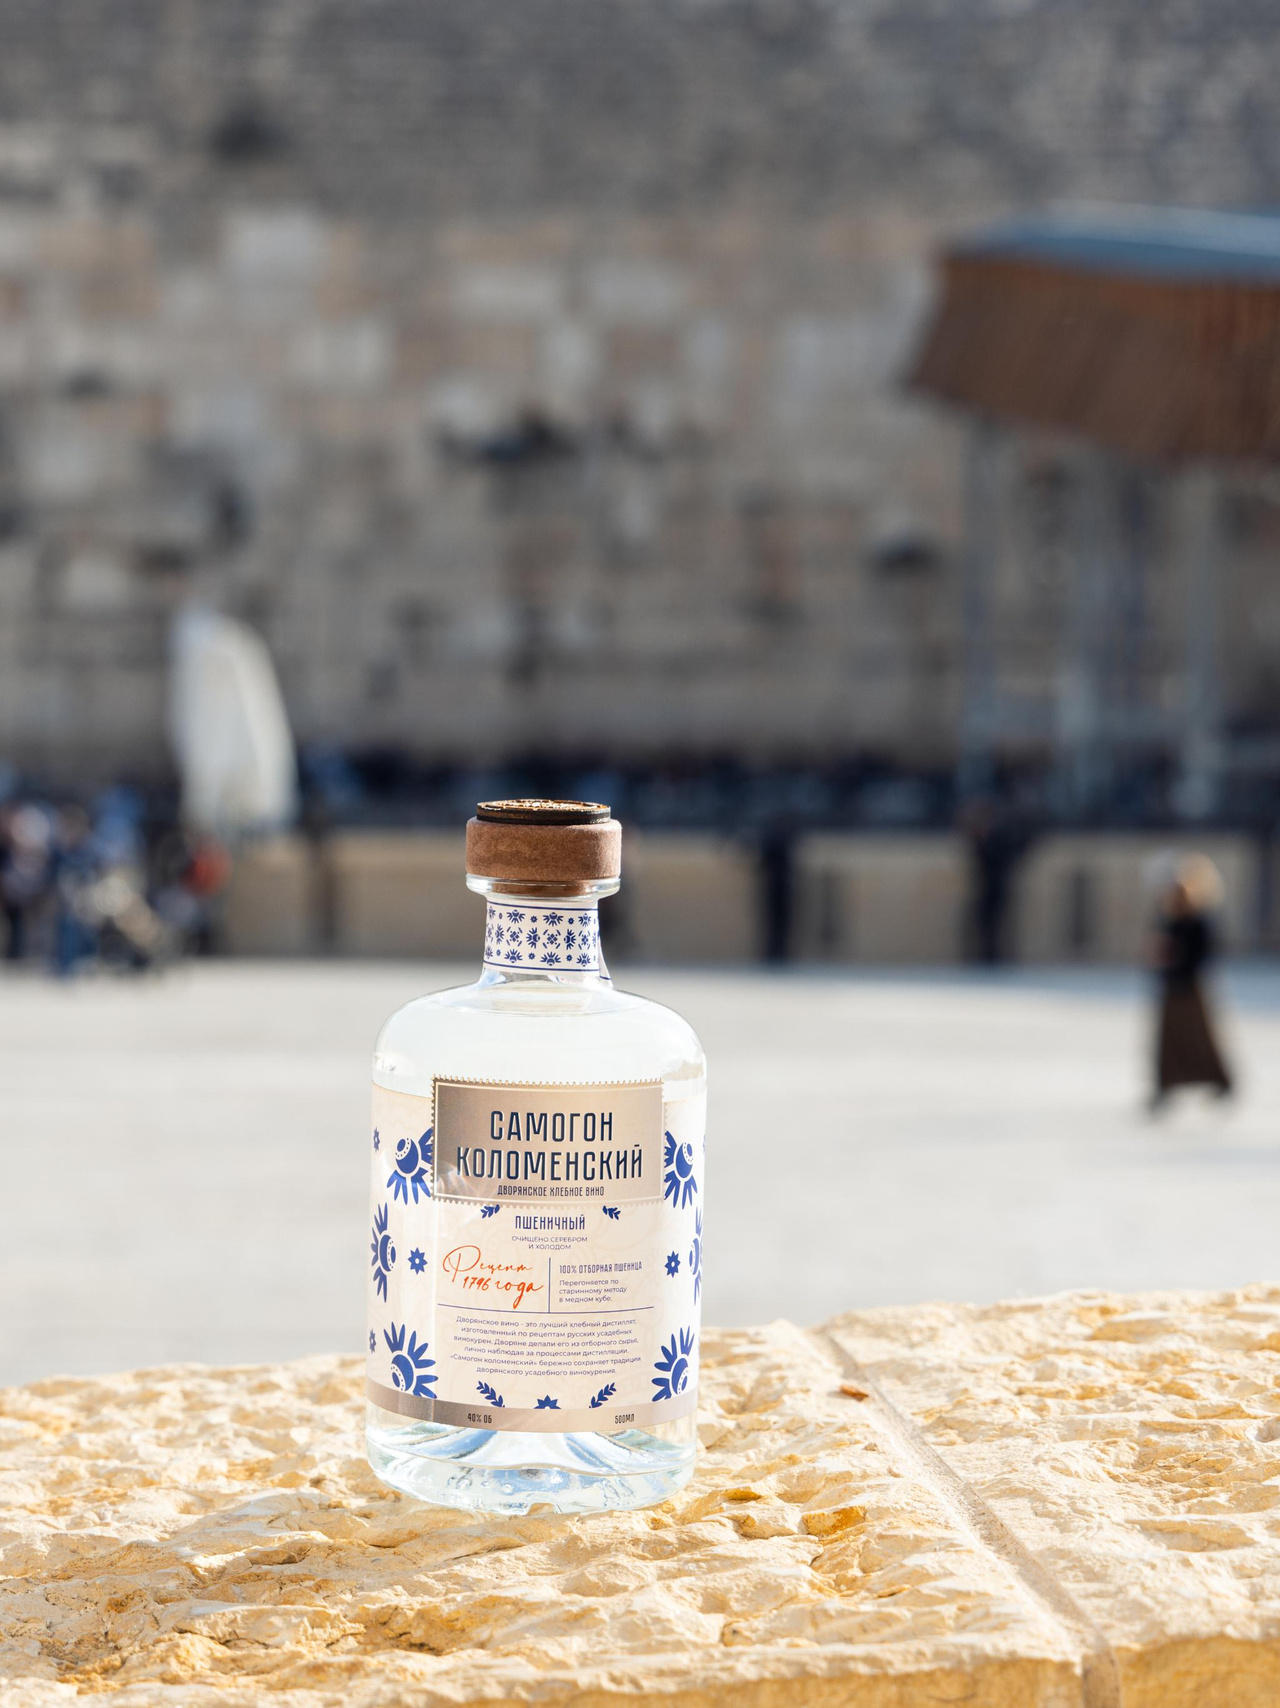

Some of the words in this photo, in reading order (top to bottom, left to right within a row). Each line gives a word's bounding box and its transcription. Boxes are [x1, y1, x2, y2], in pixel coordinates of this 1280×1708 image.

[490, 1111, 613, 1142] САМОГОН
[457, 1144, 642, 1181] КОЛОМЕНСКИЙ
[497, 1185, 547, 1197] ДВОРЯНСКОЕ
[550, 1187, 583, 1197] ХЛЕБНОЕ
[586, 1186, 604, 1196] ВИНО
[515, 1214, 585, 1230] ПШЕНИЧНЫЙ
[443, 1245, 532, 1282] Рецепт
[559, 1265, 577, 1273] 100%
[579, 1264, 613, 1274] ОТБОРНАЯ
[614, 1261, 642, 1272] ПШЕНИЦА
[463, 1276, 491, 1291] 1796
[495, 1280, 544, 1309] года
[595, 1295, 612, 1303] кубе.
[456, 1316, 499, 1325] Дворянское
[461, 1327, 516, 1336] изготовленный
[567, 1330, 595, 1338] русских
[597, 1329, 632, 1337] усадебных
[454, 1336, 493, 1344] винокурен.
[487, 1348, 524, 1356] наблюдая
[450, 1354, 482, 1362] «Самогон
[484, 1357, 537, 1366] коломенский»
[610, 1357, 641, 1365] традиции
[476, 1367, 523, 1375] дворянского
[569, 1368, 616, 1376] винокурения.
[467, 1413, 482, 1423] 40%
[614, 1413, 635, 1424] 500МЛ
